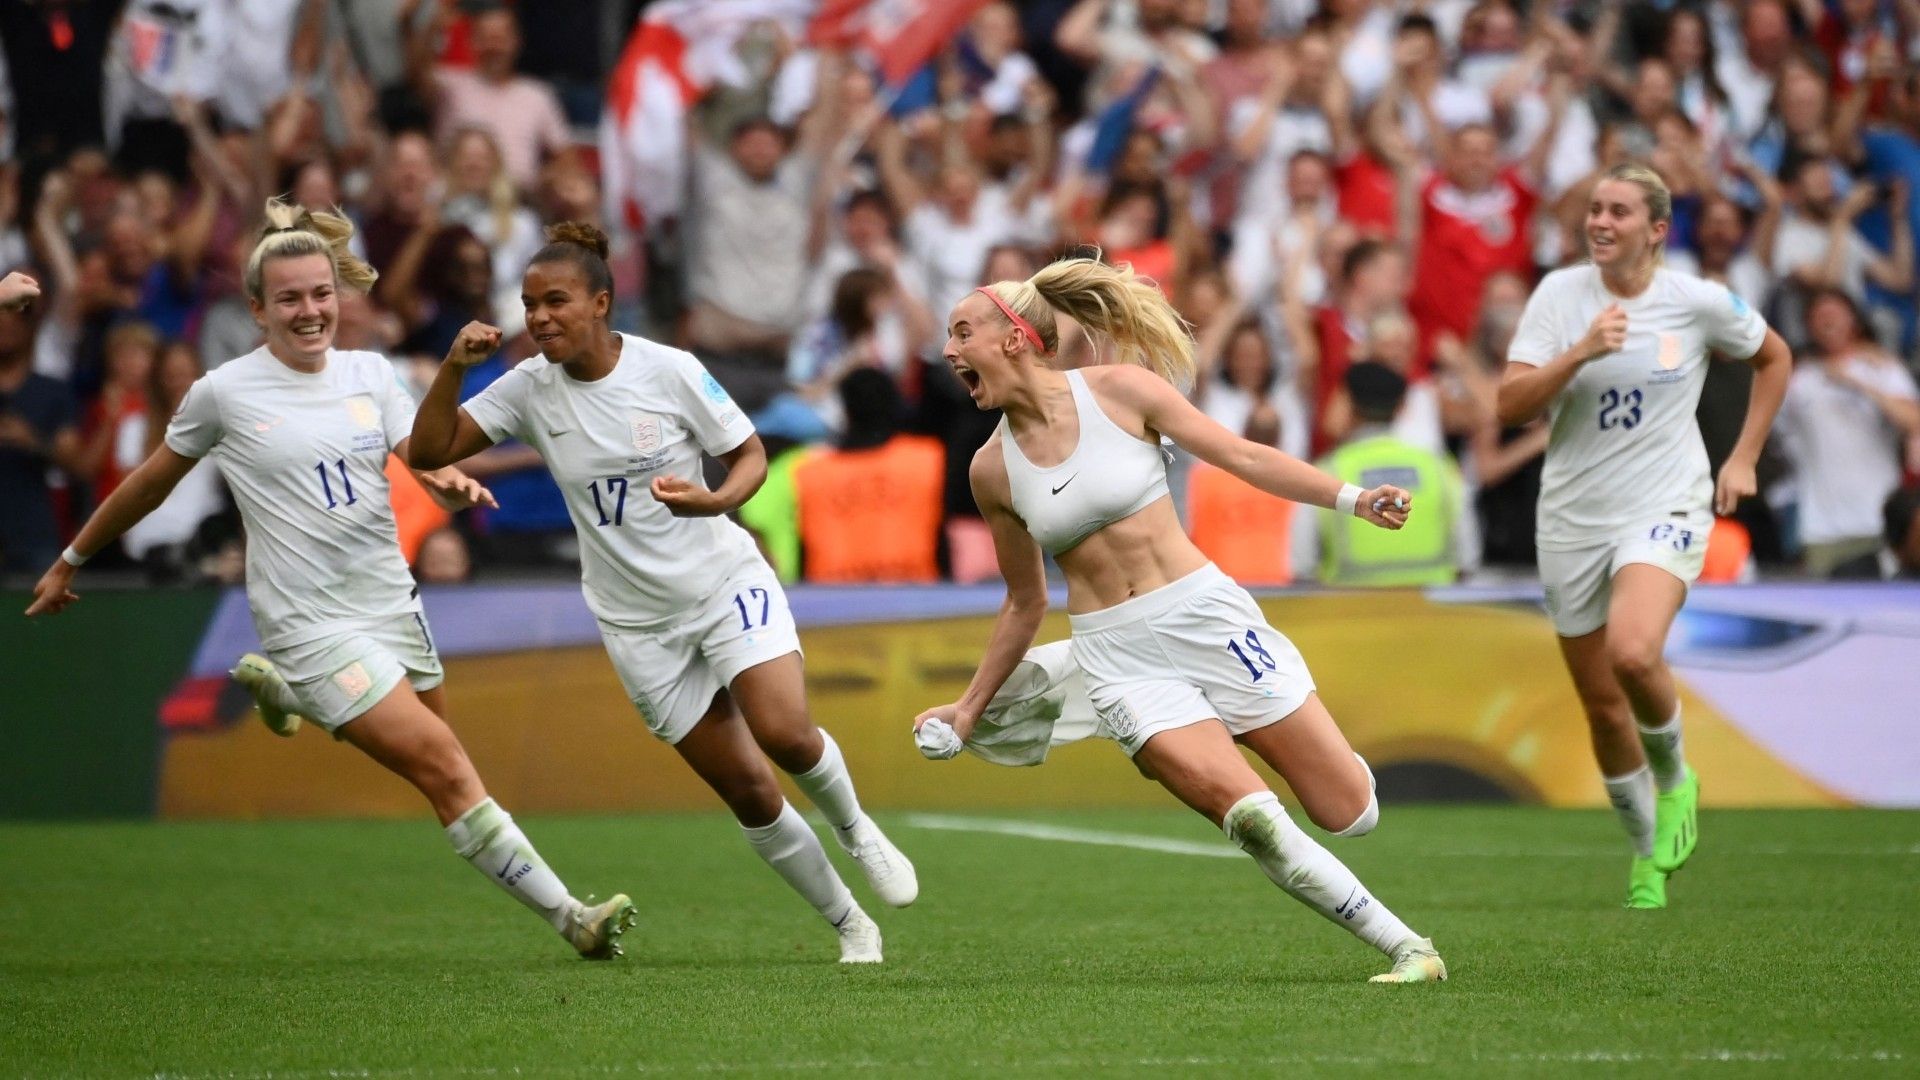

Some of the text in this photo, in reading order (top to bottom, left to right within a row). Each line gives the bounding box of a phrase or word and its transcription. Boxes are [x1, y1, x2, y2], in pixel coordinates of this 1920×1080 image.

[1599, 388, 1643, 430] 23
[315, 458, 357, 510] 11
[587, 477, 628, 526] 17
[733, 588, 769, 631] 17
[1227, 629, 1276, 683] 18
